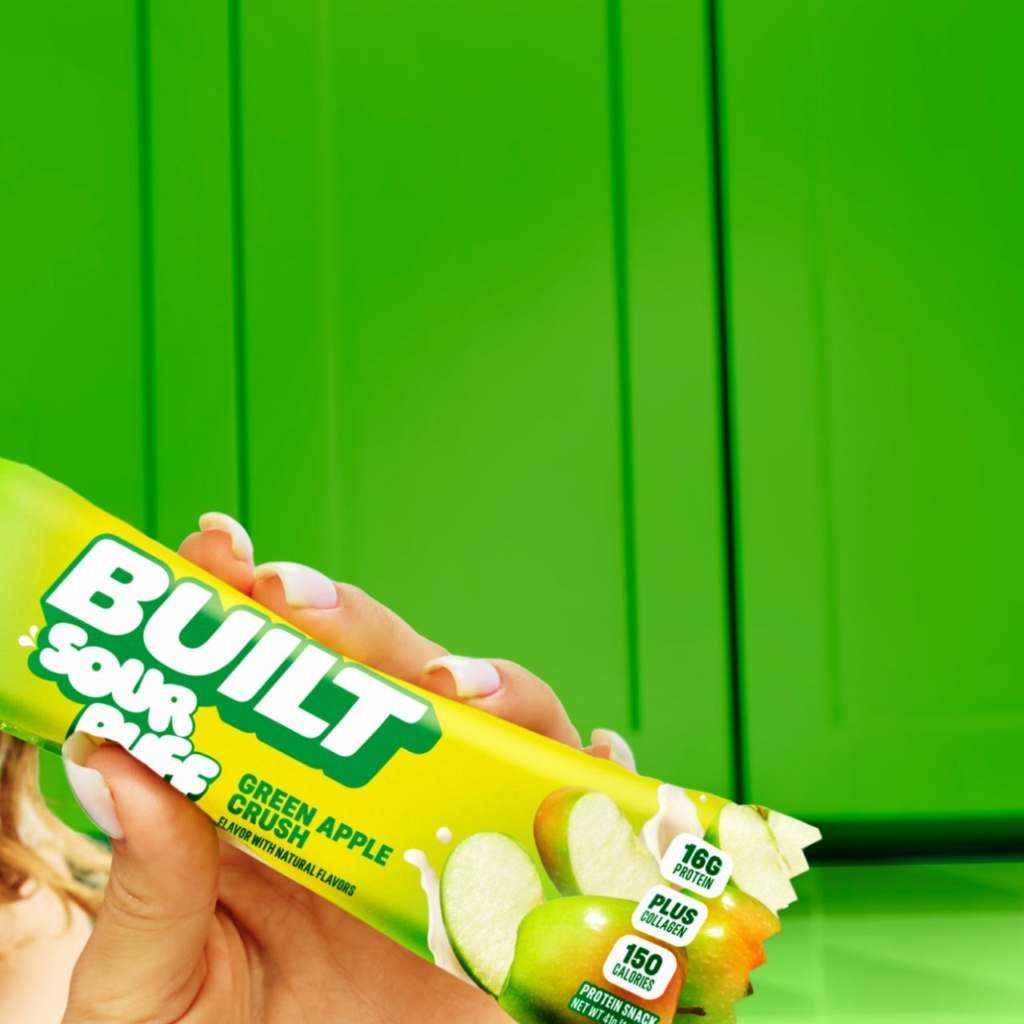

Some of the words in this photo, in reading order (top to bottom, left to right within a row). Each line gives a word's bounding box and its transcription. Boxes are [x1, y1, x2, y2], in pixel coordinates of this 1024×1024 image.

[44, 537, 431, 759] BUILT
[38, 621, 198, 738] SOUR
[227, 794, 311, 849] CRUSH
[238, 773, 318, 827] GREEN
[316, 816, 394, 867] APPLE
[217, 816, 253, 844] FLAVOR
[251, 834, 278, 855] WITH
[275, 847, 317, 877] NATURAL
[315, 868, 357, 897] FLAVORS
[681, 843, 723, 877] 16G
[672, 863, 715, 890] PROTEIN
[640, 909, 688, 938] COLLAGEN
[648, 893, 698, 926] PLUS
[622, 943, 664, 976] 150
[612, 963, 656, 992] CALORIES
[570, 997, 591, 1013] NET
[588, 1005, 604, 1019] WT
[579, 984, 624, 1014] PROTEIN
